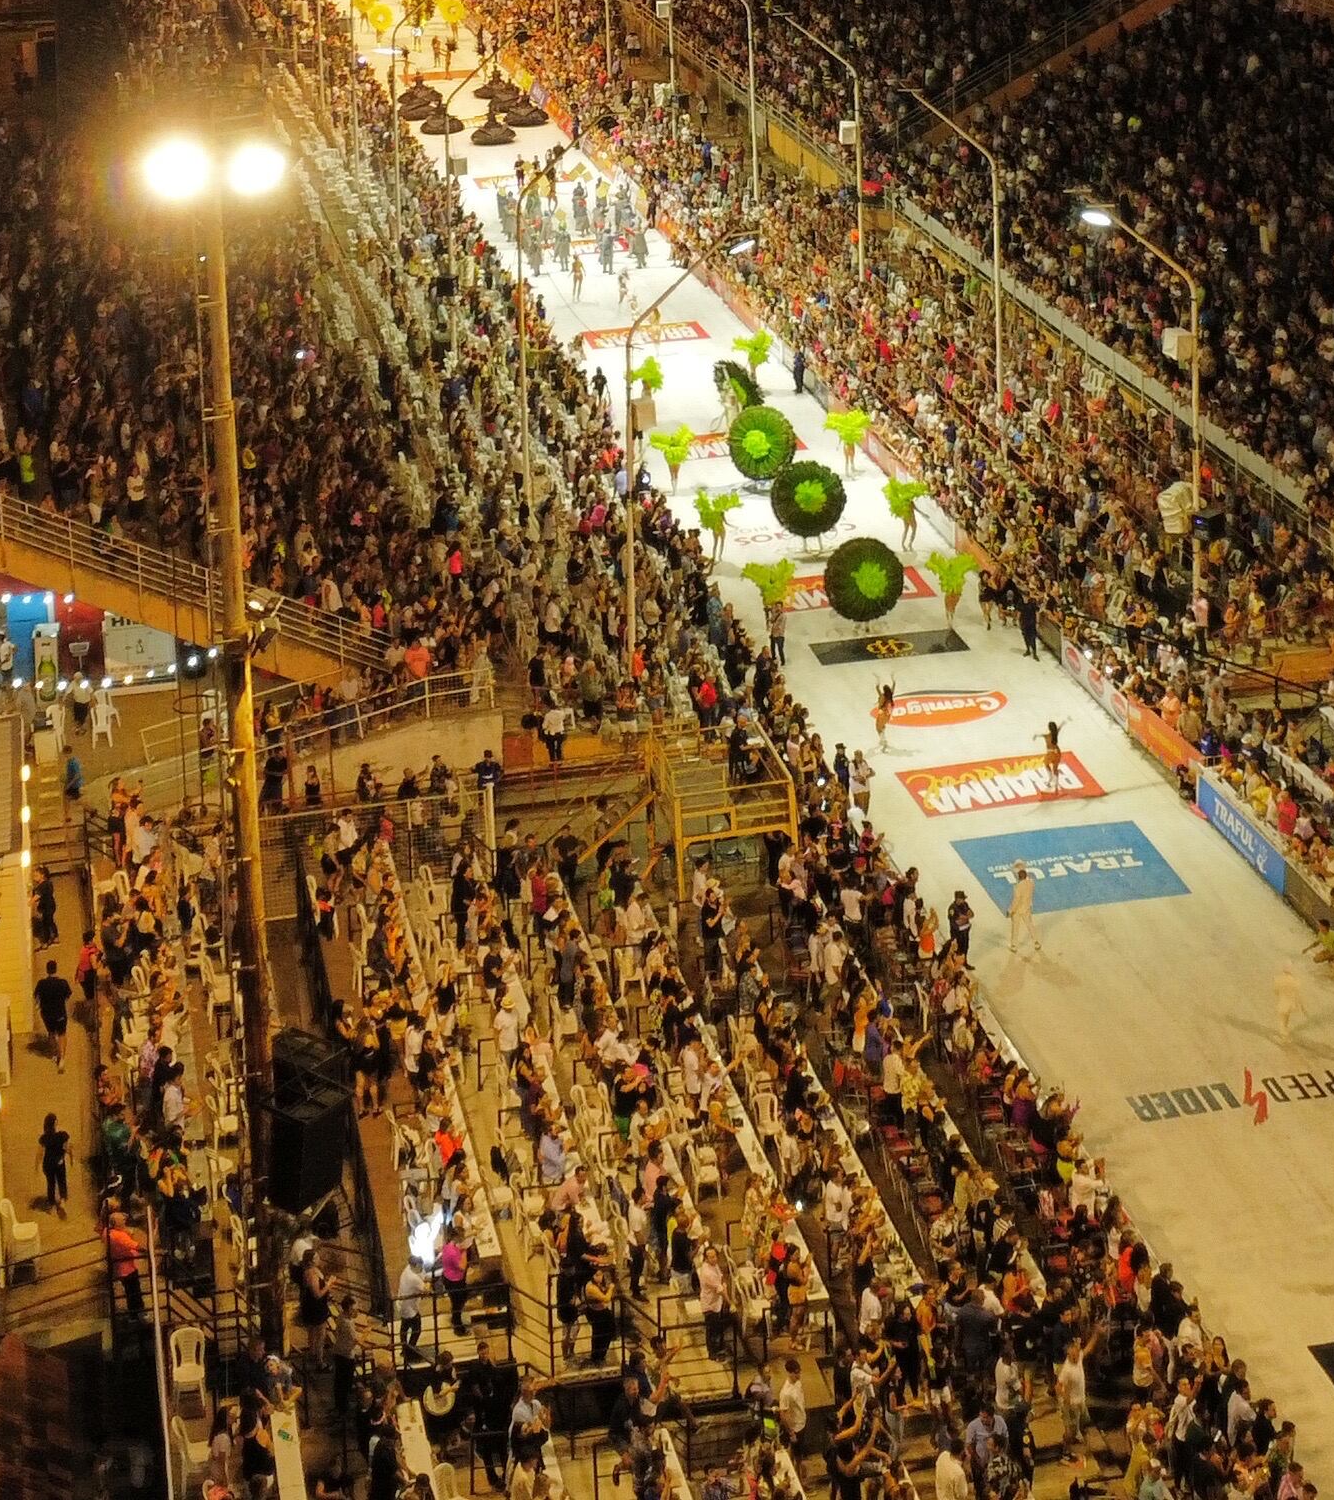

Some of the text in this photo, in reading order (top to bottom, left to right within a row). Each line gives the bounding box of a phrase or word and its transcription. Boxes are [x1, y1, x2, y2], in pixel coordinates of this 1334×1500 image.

[889, 696, 1001, 721] Cremiga
[916, 762, 1084, 814] BRAHMA
[1213, 796, 1255, 853] TRAFUL
[987, 854, 1074, 873] Revestimntos
[1125, 1081, 1242, 1124] LIDER
